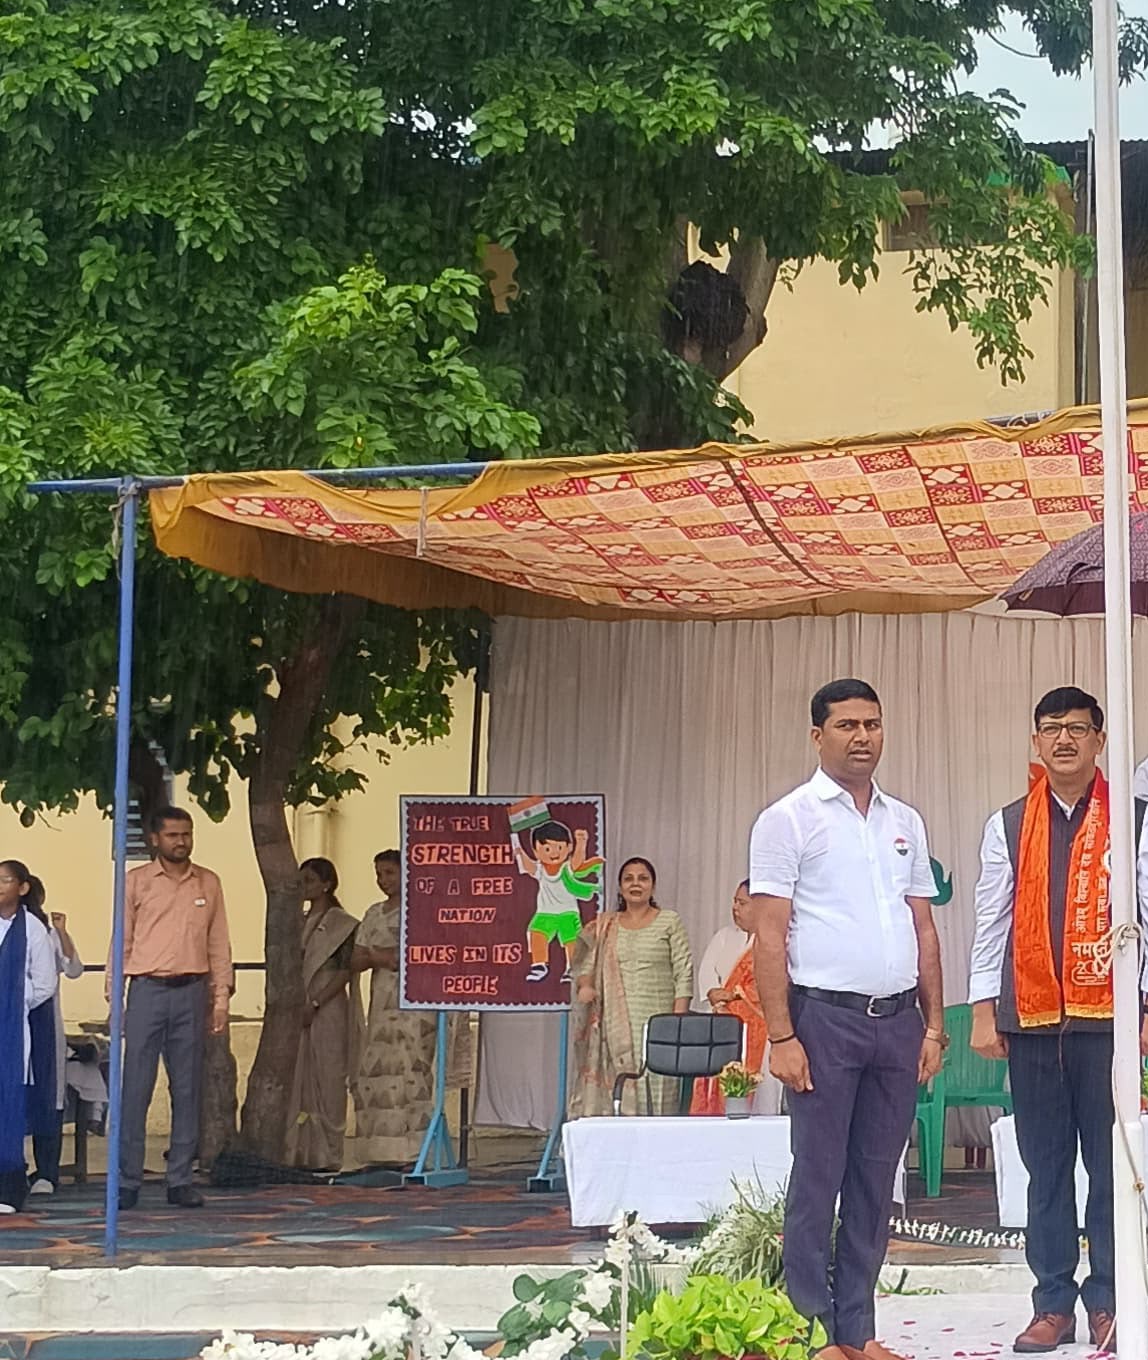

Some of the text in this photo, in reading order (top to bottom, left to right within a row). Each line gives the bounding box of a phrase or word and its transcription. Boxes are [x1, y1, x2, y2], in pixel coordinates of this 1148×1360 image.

[414, 815, 490, 832] THE TRUE
[412, 844, 513, 865] STRENGTH
[416, 876, 513, 895] OF A FREE
[438, 907, 496, 923] NATION
[409, 943, 522, 965] LIVES IN ITS
